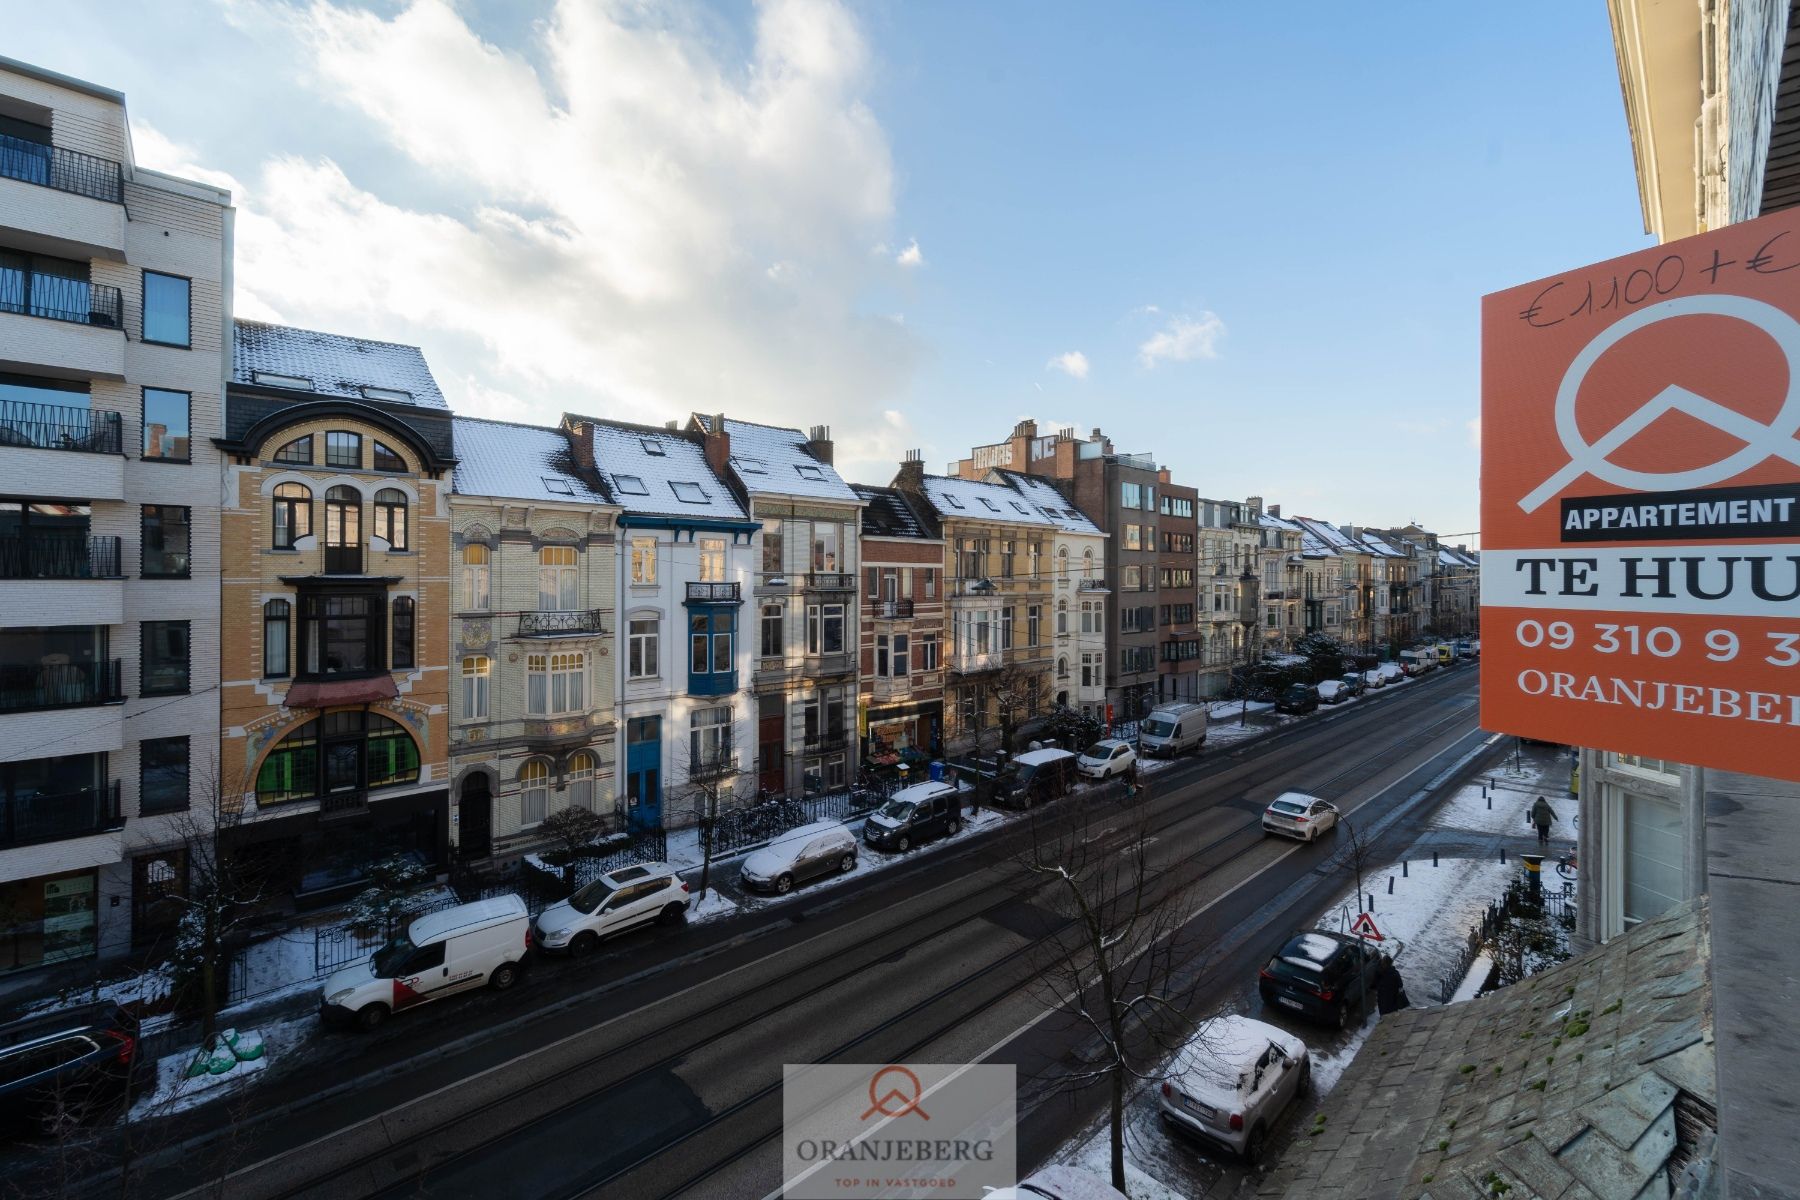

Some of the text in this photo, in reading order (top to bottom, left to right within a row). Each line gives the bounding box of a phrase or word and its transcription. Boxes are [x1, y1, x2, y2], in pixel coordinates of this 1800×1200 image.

[1565, 498, 1796, 530] APPARTEMENT
[1515, 558, 1599, 597] TE
[1516, 619, 1800, 667] 09 310 9 3
